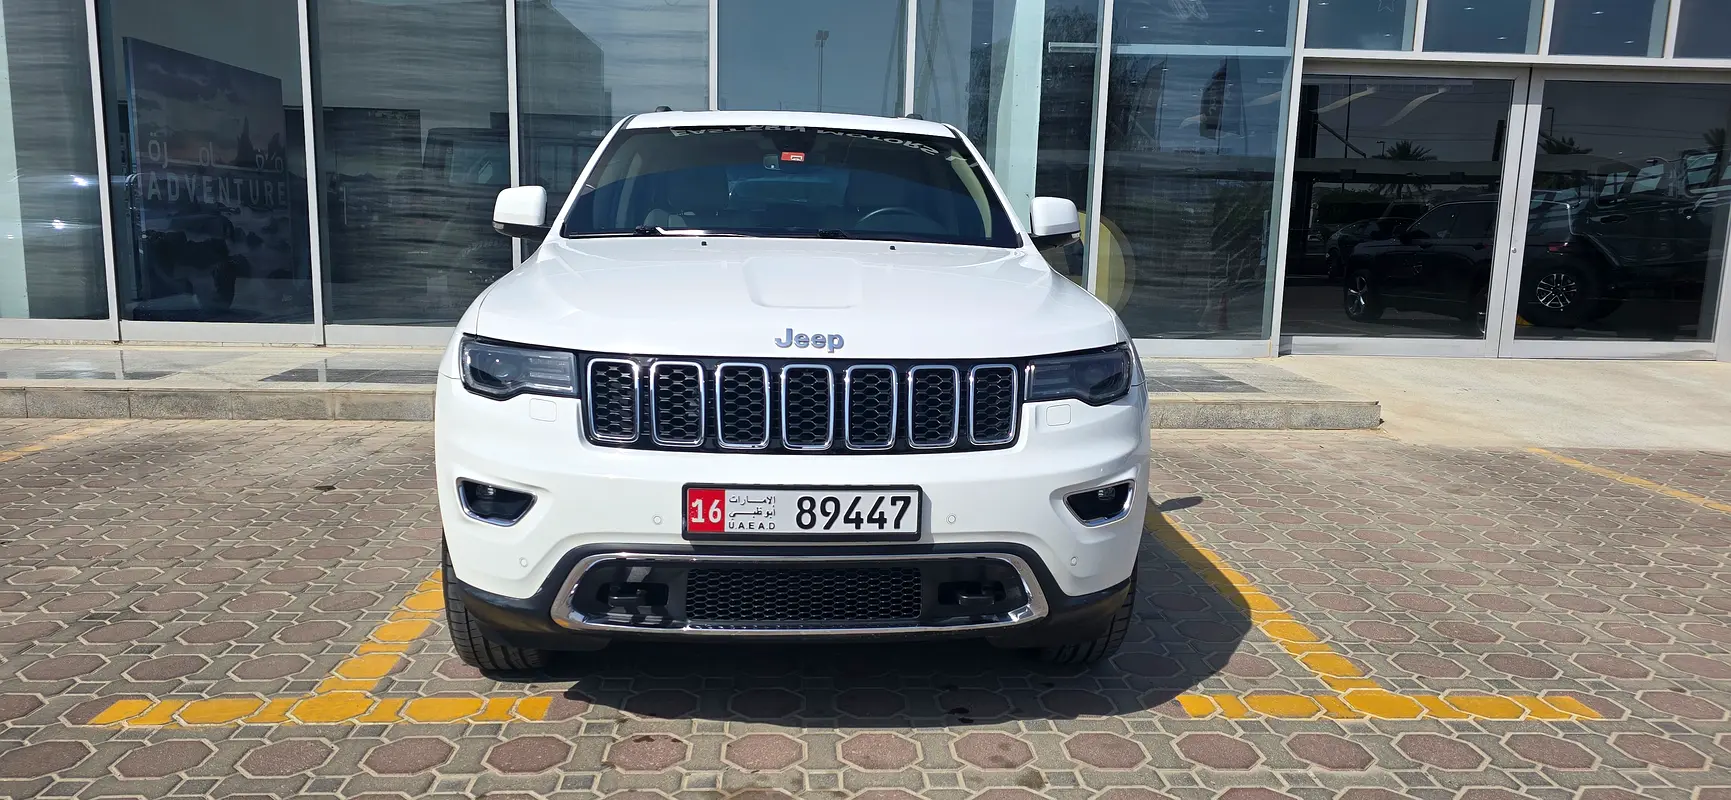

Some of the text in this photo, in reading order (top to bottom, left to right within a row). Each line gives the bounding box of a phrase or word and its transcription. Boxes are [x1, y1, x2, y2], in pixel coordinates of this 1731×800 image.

[147, 170, 286, 206] ADVENTURE
[774, 327, 845, 354] Jeep
[691, 498, 723, 524] 16
[795, 495, 912, 531] 89447
